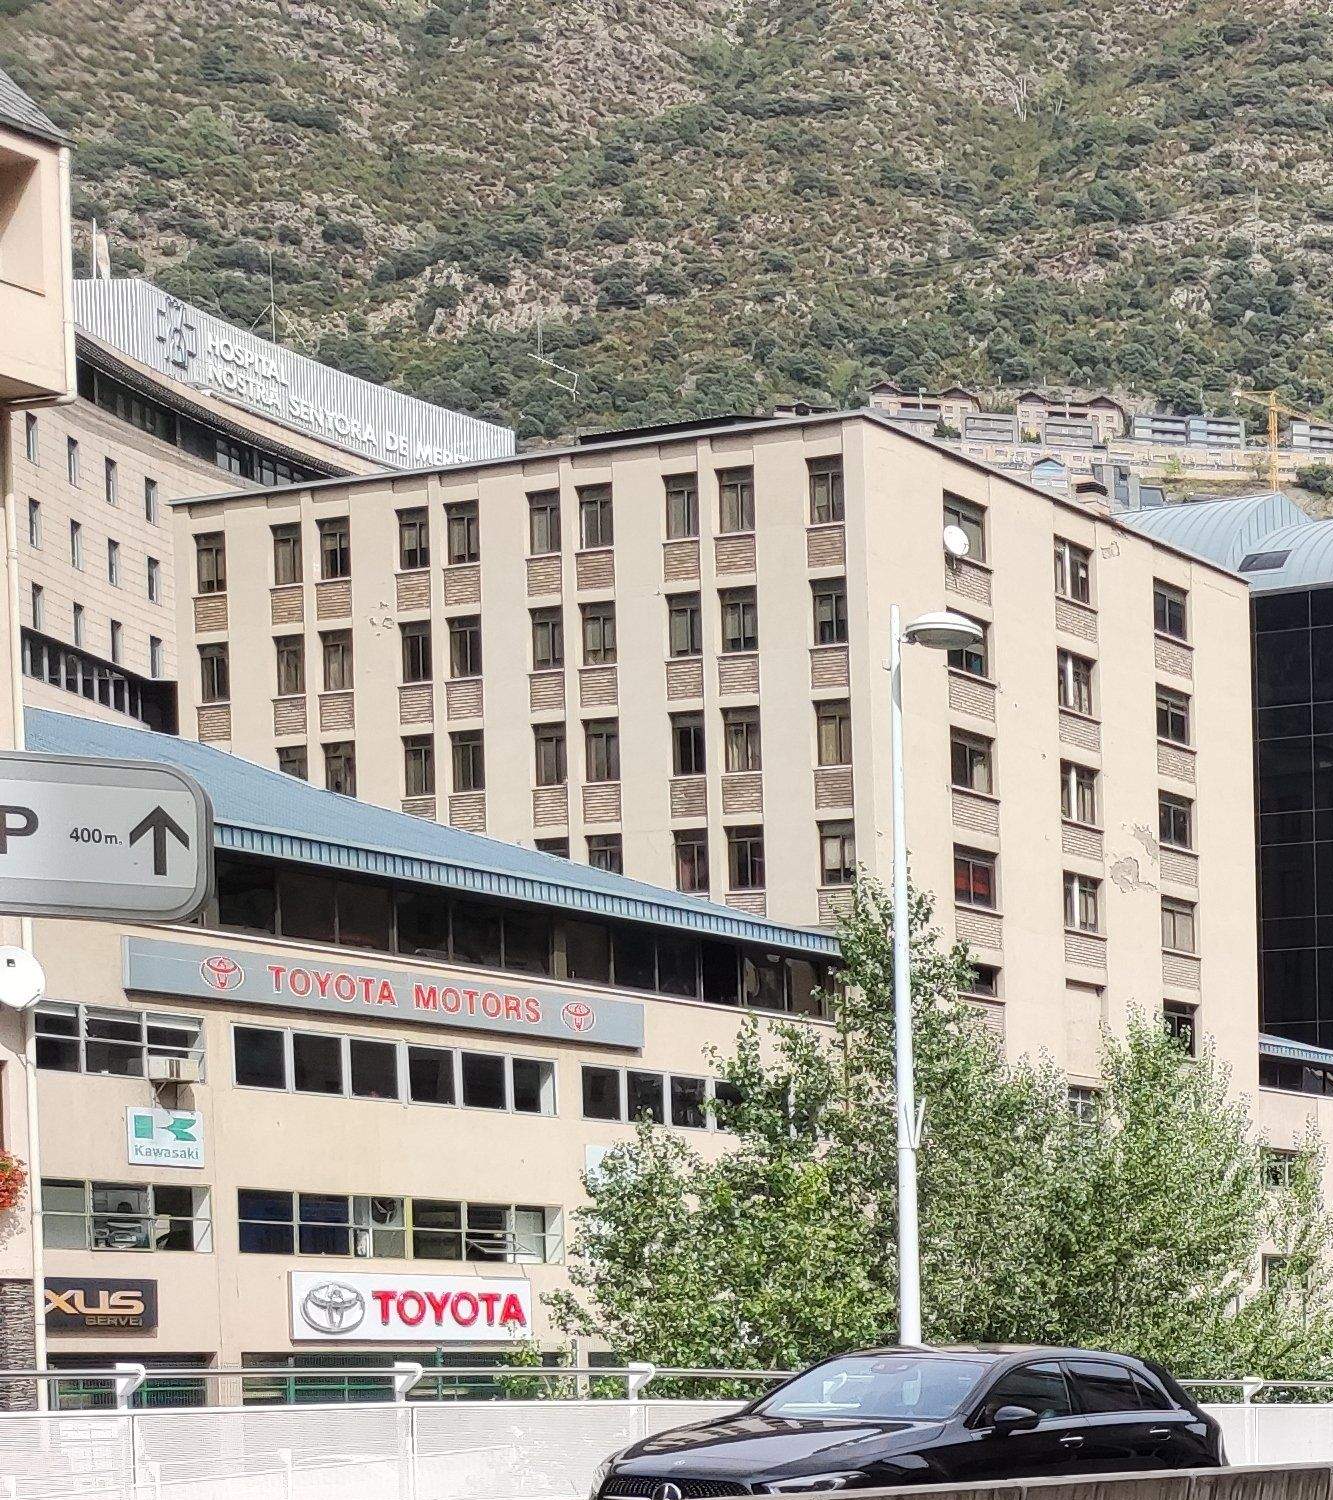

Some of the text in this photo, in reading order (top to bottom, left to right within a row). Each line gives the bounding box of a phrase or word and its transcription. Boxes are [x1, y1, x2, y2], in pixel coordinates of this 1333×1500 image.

[207, 332, 288, 387] HOSPITAL
[207, 360, 282, 411] NOSTRA
[288, 396, 377, 446] SENYORA
[385, 430, 408, 457] DE
[267, 964, 543, 1025] TOYOTA MOTORS
[134, 1144, 199, 1161] Kawasaki
[371, 1290, 528, 1327] TOYOTA
